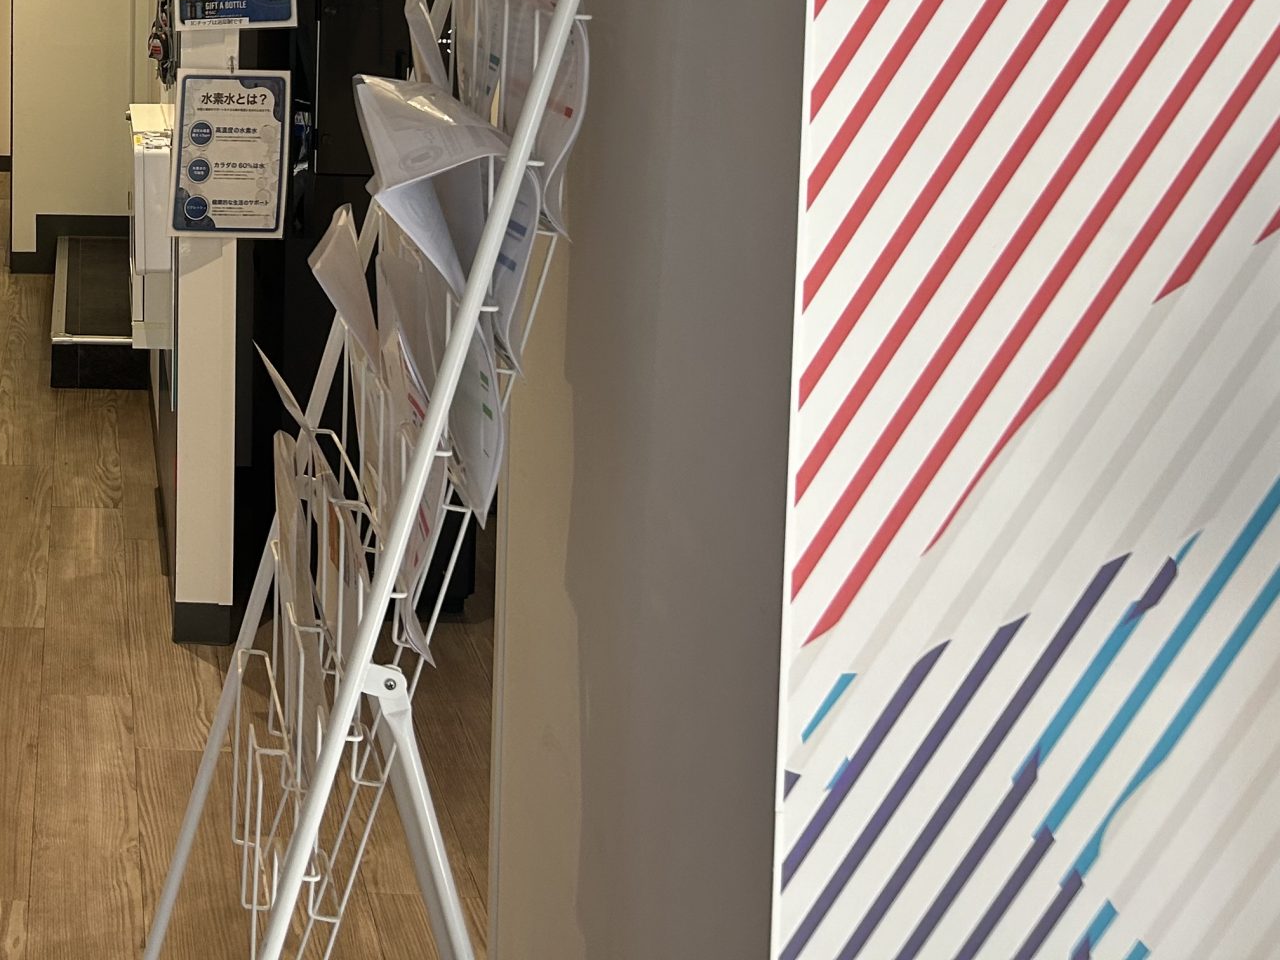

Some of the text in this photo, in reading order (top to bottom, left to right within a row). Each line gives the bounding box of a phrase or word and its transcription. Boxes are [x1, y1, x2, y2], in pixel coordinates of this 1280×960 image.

[205, 0, 247, 10] GIFT A BOTTLE
